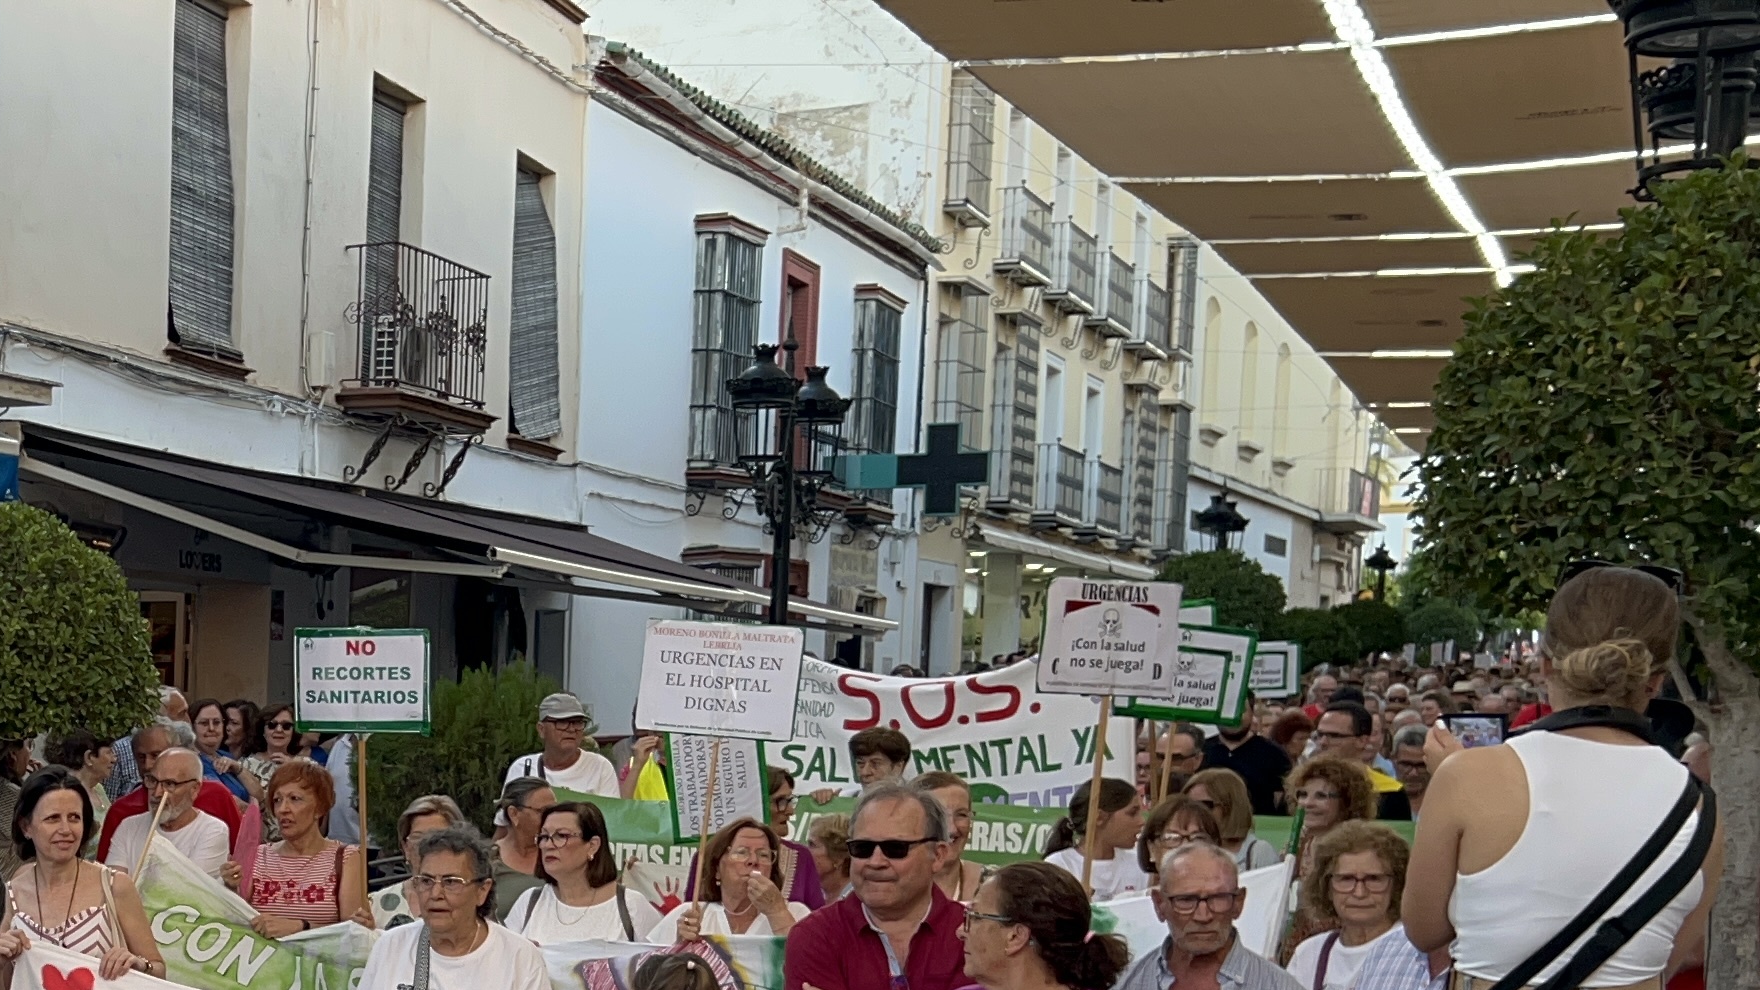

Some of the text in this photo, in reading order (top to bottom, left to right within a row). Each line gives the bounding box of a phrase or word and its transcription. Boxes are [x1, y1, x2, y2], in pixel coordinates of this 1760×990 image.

[1081, 582, 1149, 603] URGENCIAS
[653, 626, 795, 644] MORENO BONILLA MALTRATA
[1071, 637, 1146, 653] ¡Con la salud
[345, 639, 377, 656] NO
[660, 650, 784, 672] URGENCIAS EN
[1069, 656, 1144, 673] no se juega!
[311, 666, 412, 681] RECORTES
[665, 672, 772, 694] EL HOSPITAL
[799, 677, 838, 695] EFENSA
[1187, 678, 1216, 691] salud
[304, 689, 419, 705] SANITARIOS
[684, 696, 747, 714] DIGNAS
[837, 673, 1042, 731] S.O.S.
[1177, 692, 1214, 707] juega!
[796, 719, 826, 740] LICA
[781, 724, 1115, 784] SAL MENTAL YA
[682, 735, 699, 815] TRABAJADOR
[721, 746, 734, 795] SEGURO
[734, 750, 747, 789] SALUD
[608, 842, 664, 871] ITAS
[150, 903, 277, 987] CON
